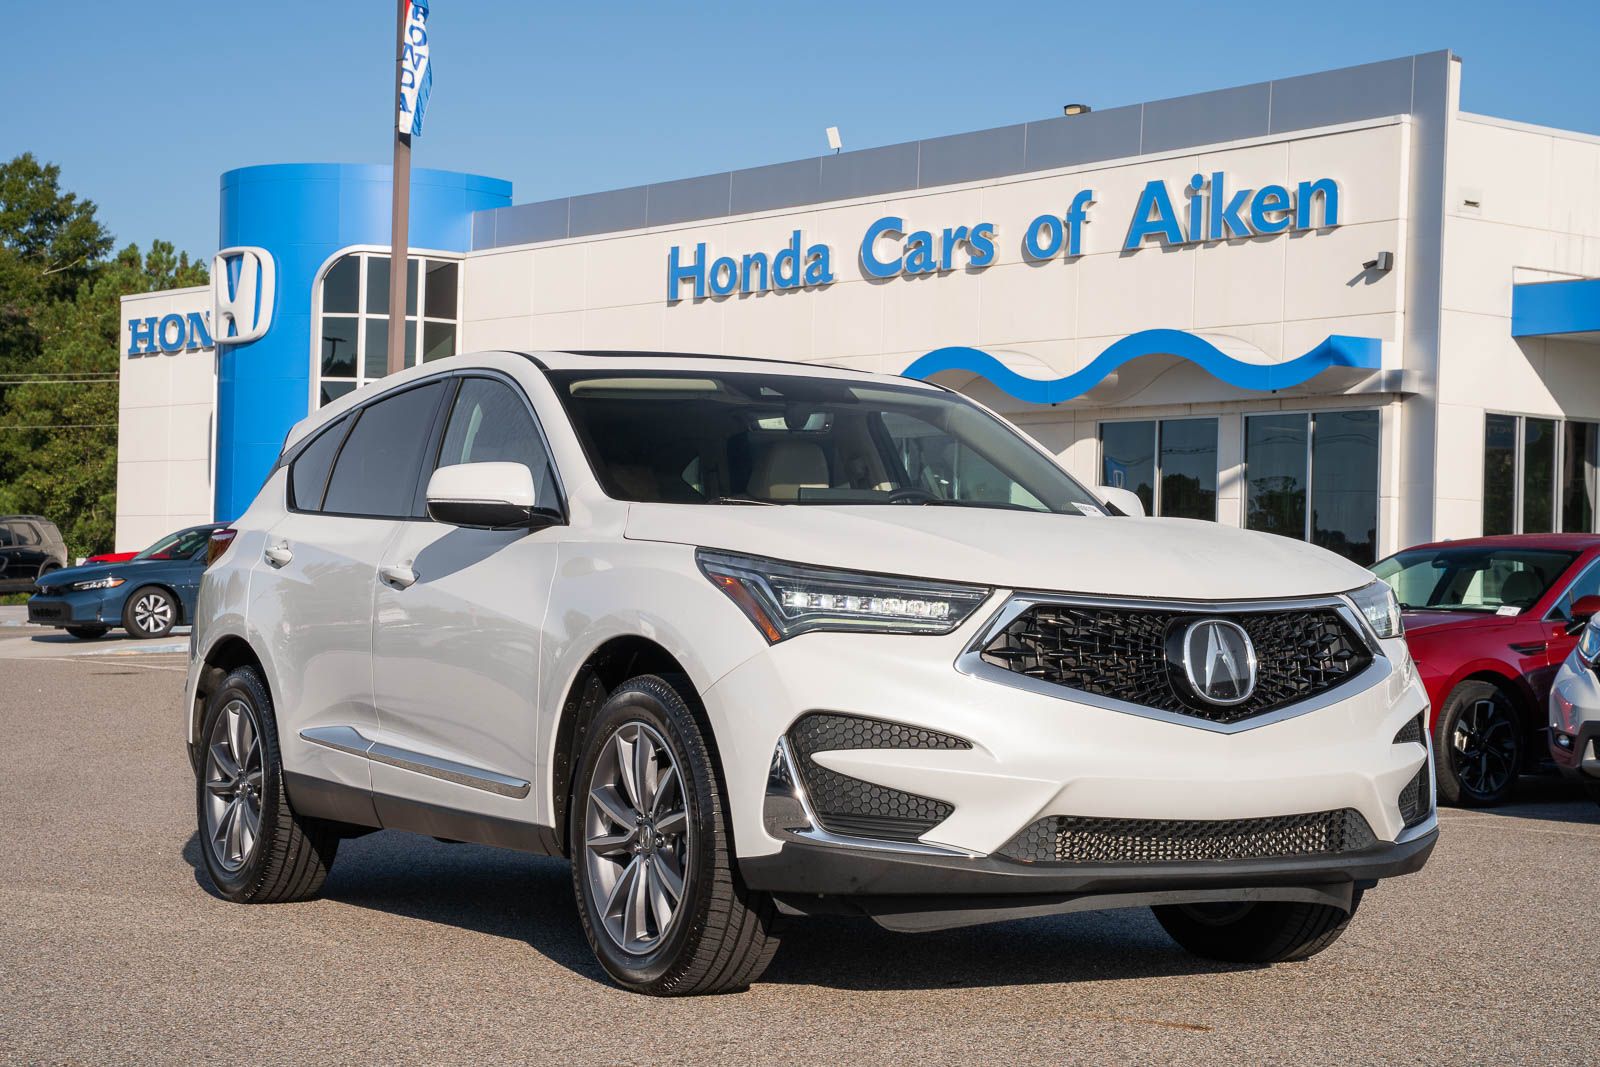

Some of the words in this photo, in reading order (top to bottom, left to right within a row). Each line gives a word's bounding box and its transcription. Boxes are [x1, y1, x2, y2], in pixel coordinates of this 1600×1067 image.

[668, 230, 835, 301] Honda
[863, 217, 994, 276] Cars
[1027, 190, 1092, 258] of
[1127, 172, 1338, 248] Aiken
